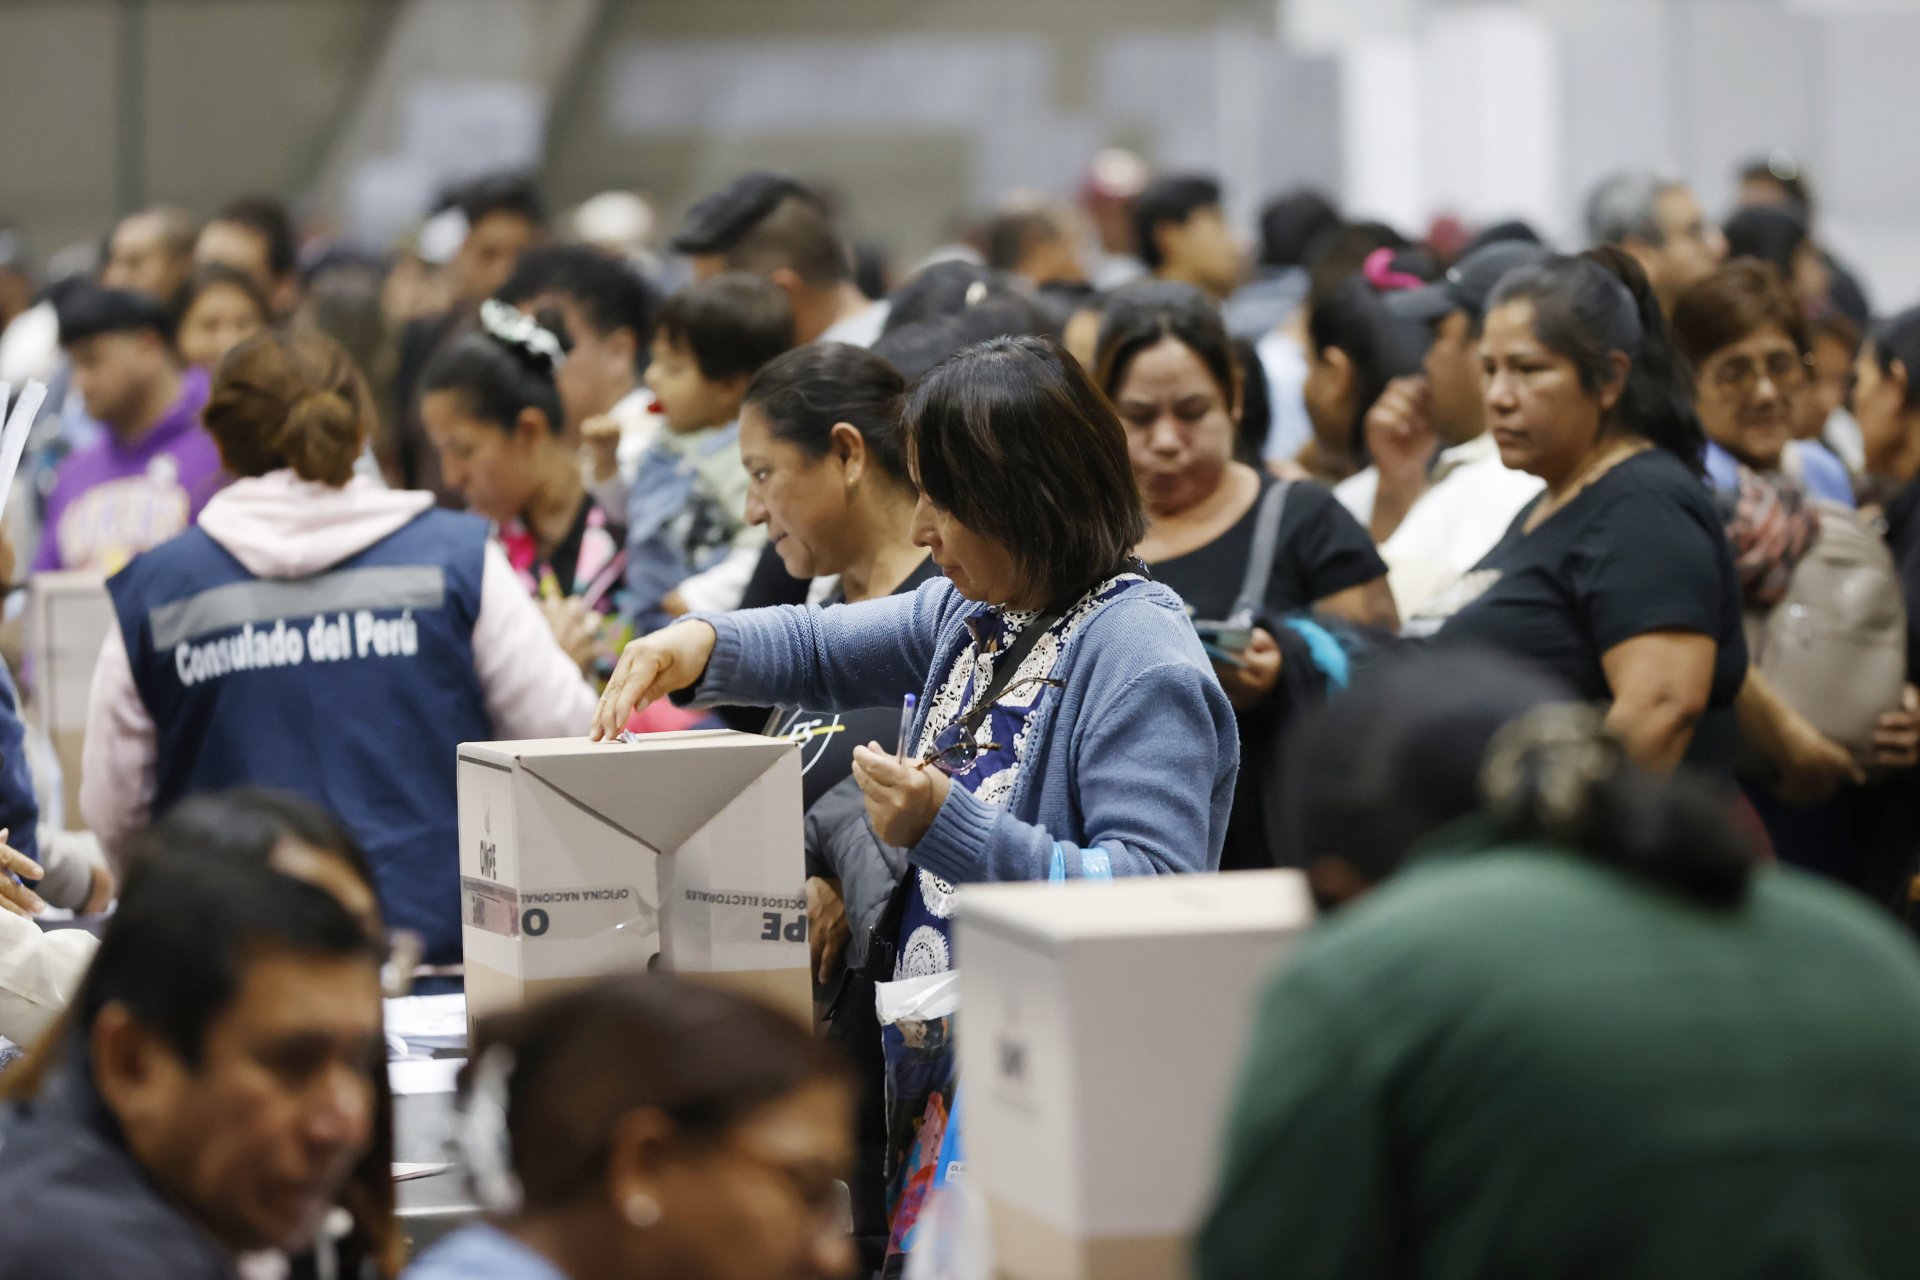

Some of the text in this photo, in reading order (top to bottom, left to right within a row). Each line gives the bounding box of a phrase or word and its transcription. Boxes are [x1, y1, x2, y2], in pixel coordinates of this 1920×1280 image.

[175, 607, 418, 686] Consulado del Perú
[520, 891, 580, 904] NACIONAL
[582, 888, 629, 900] OFICINA
[685, 889, 759, 907] ELECTORALES
